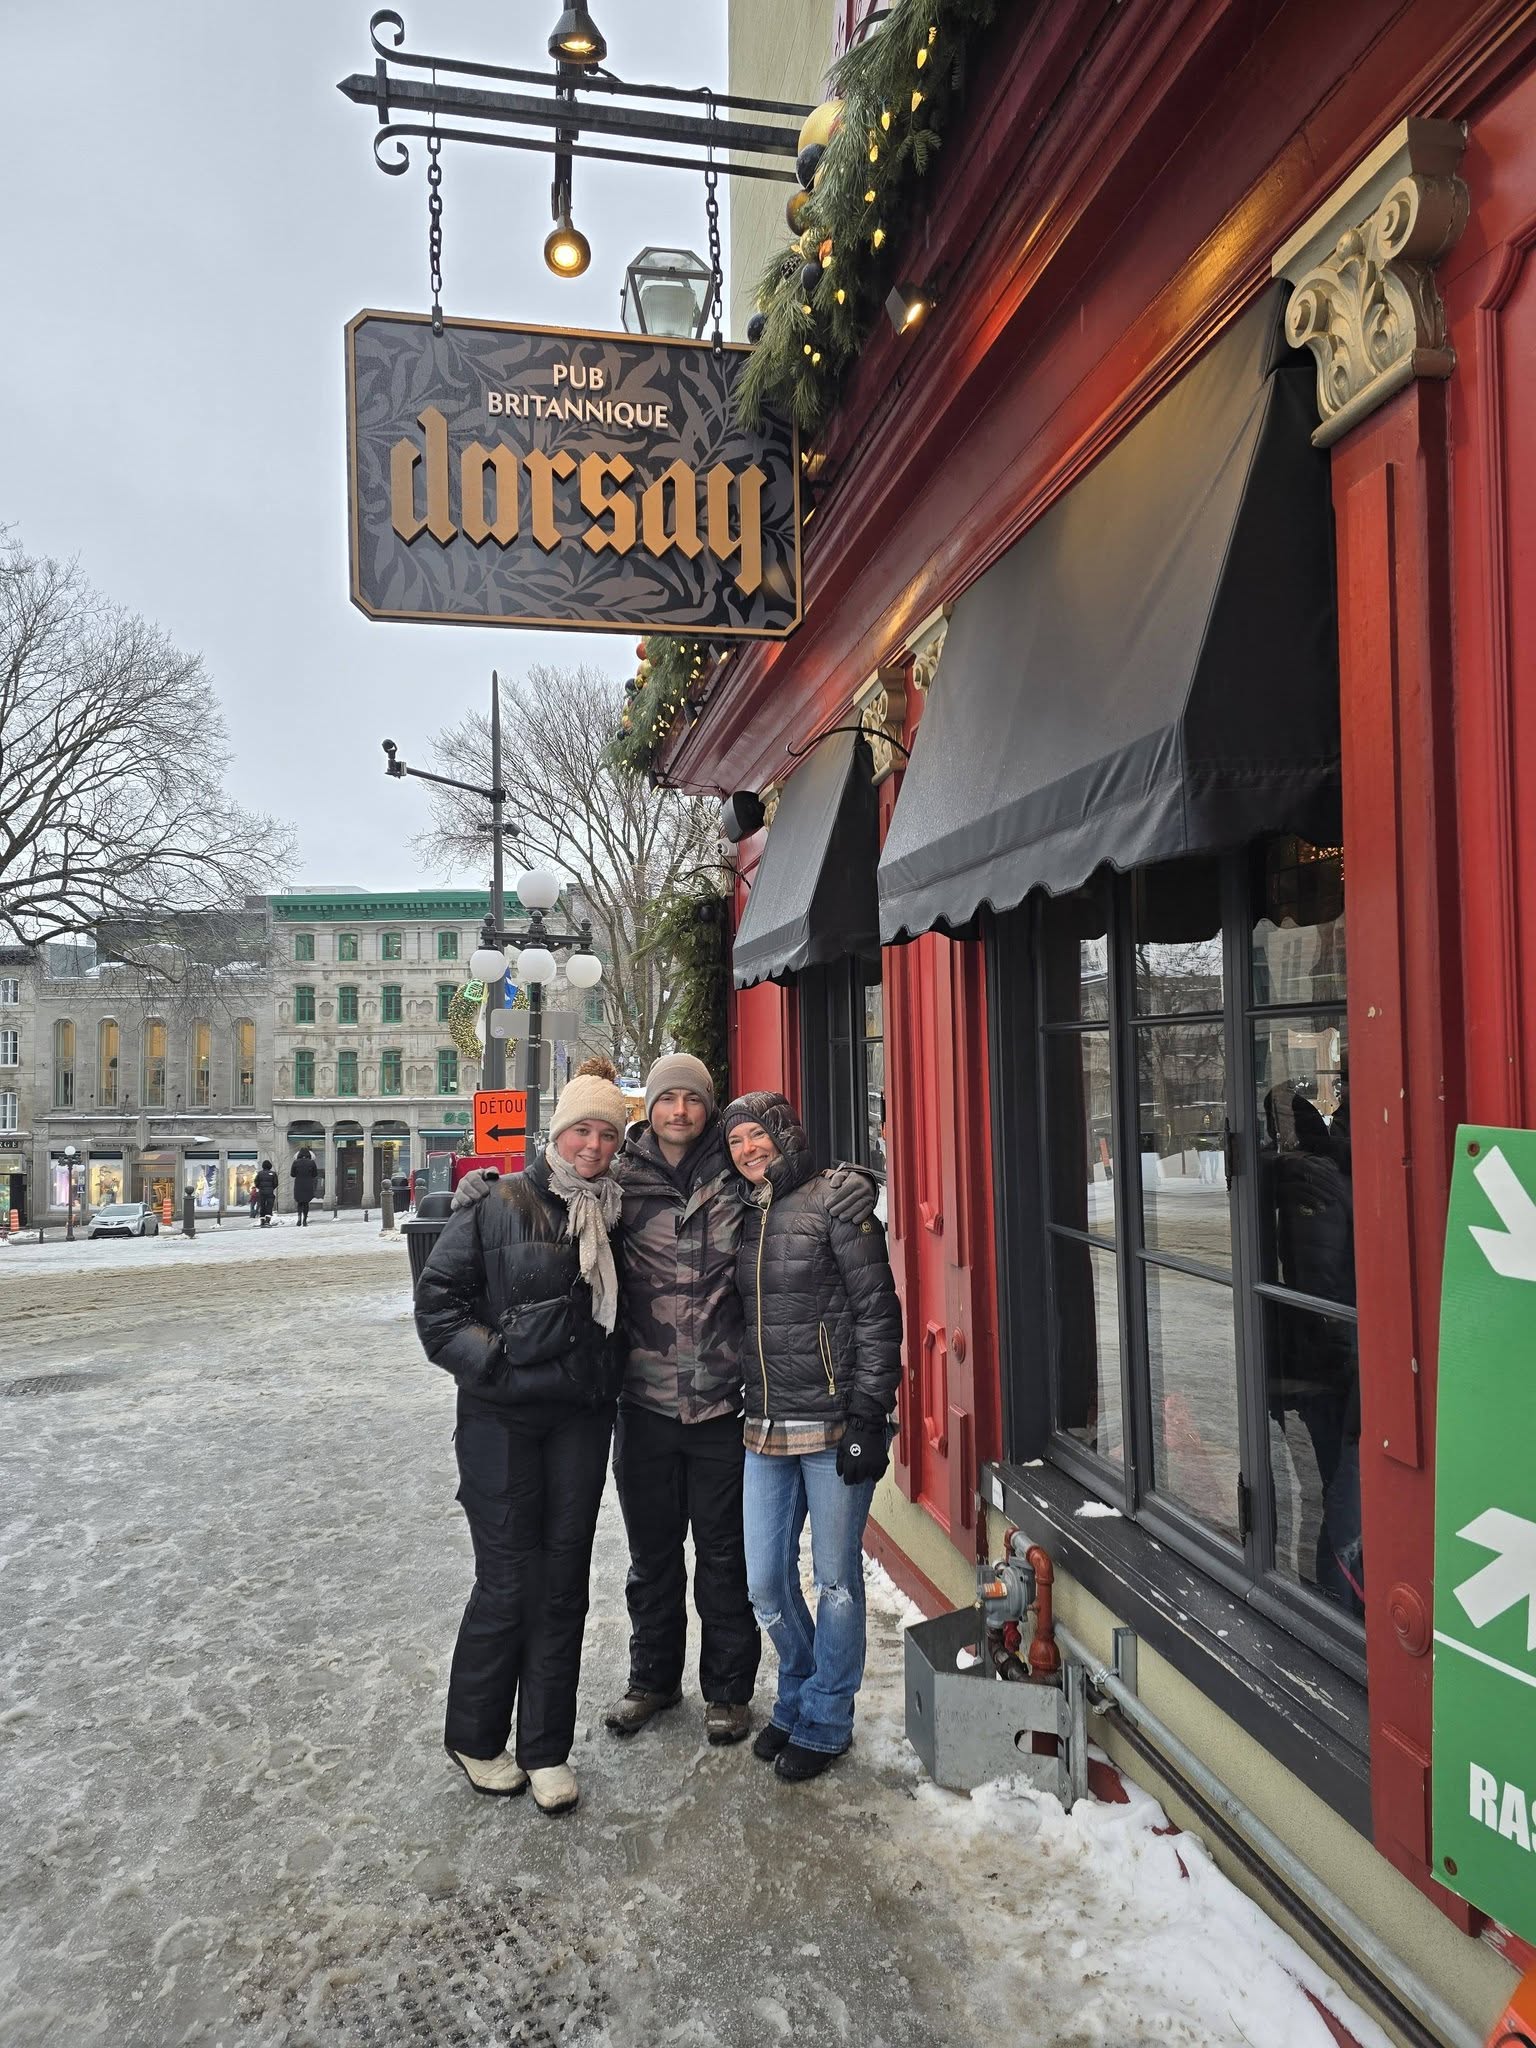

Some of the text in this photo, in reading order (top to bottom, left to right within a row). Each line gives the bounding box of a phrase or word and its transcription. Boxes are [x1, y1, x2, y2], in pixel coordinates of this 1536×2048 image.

[553, 364, 604, 391] PUB
[488, 391, 669, 429] BRITANNIQUE
[390, 405, 768, 597] dorsay
[480, 1097, 527, 1114] DÉTOU
[1469, 1761, 1536, 1853] RA
